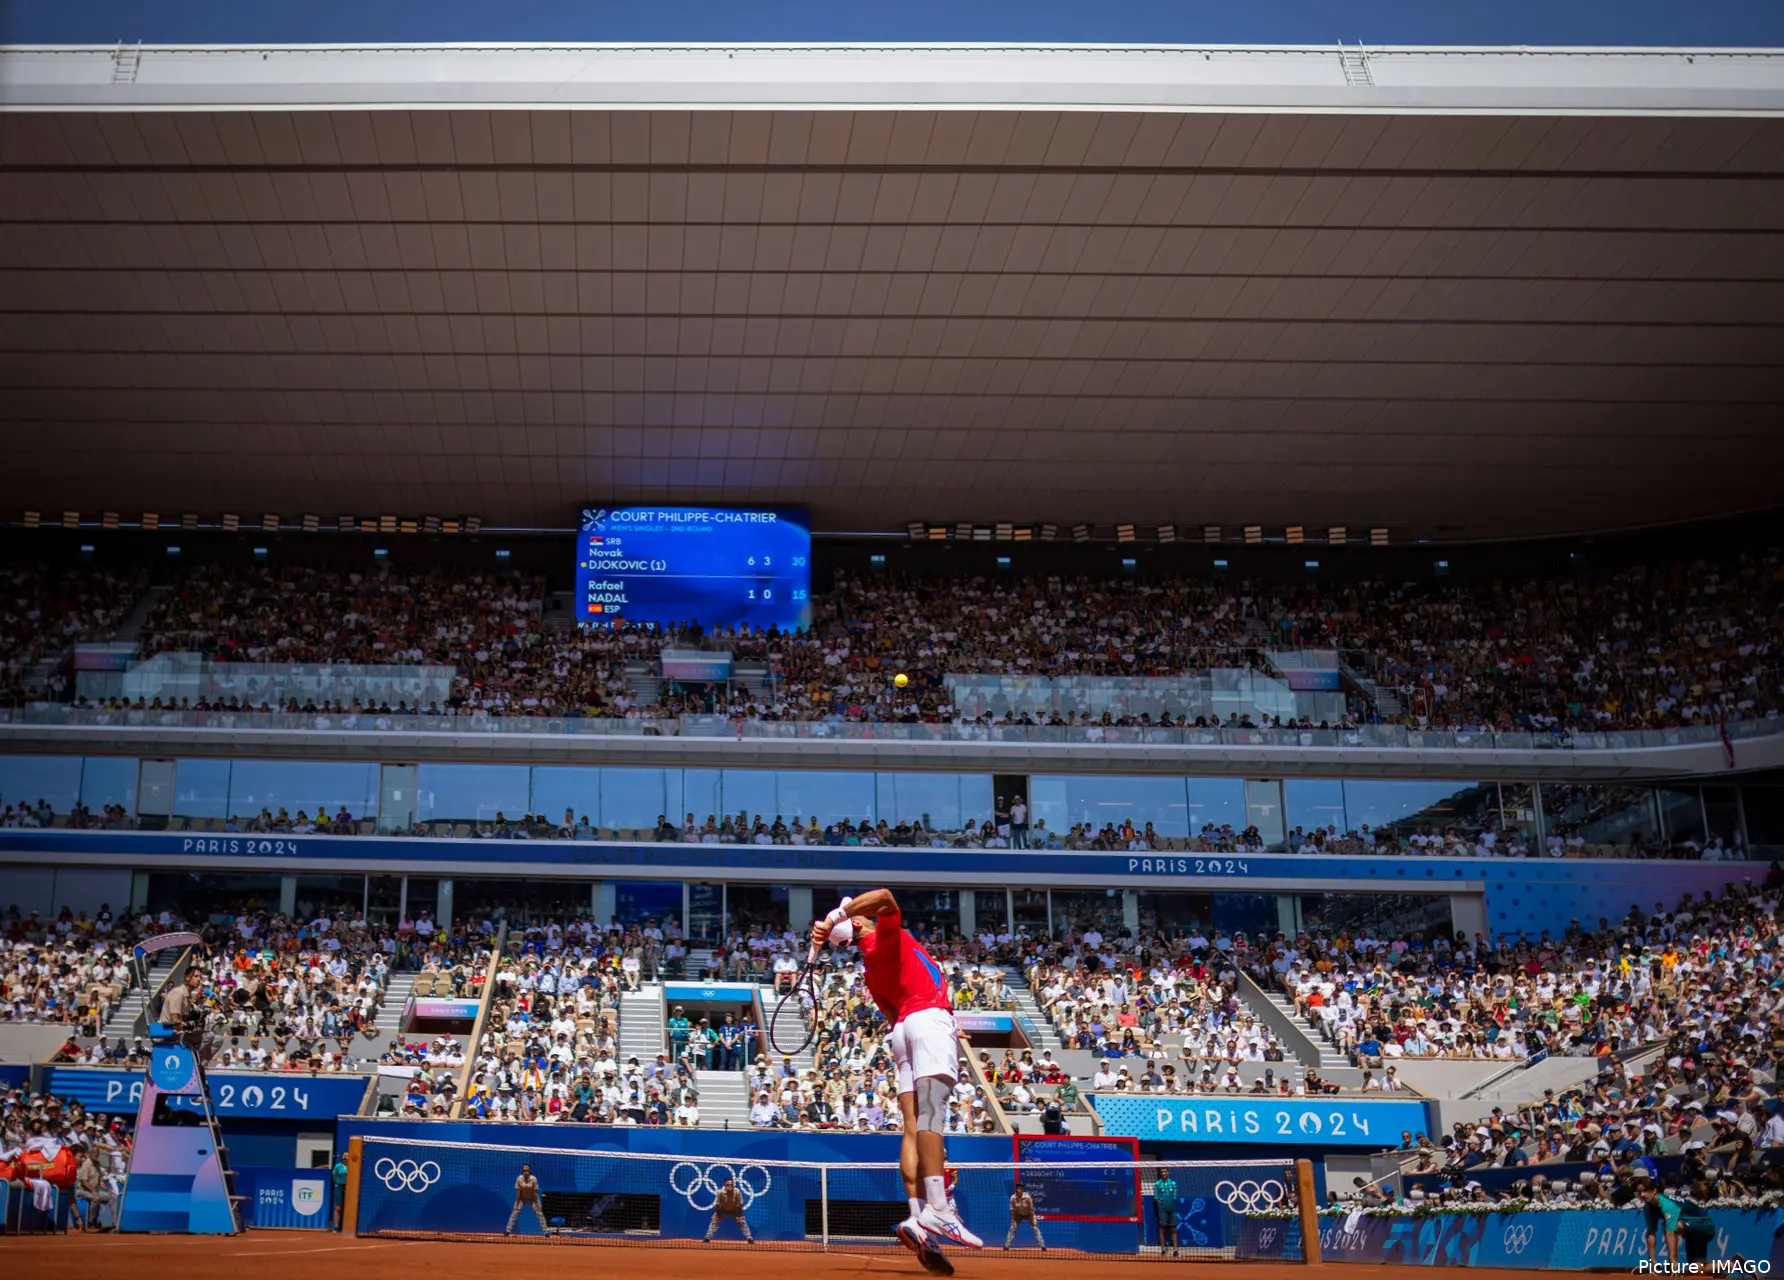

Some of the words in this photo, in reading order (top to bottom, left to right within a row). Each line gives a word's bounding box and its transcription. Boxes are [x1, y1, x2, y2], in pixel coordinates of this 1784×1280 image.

[611, 511, 654, 522] COURT
[658, 512, 777, 523] PHILIPPE-CHATRIER
[605, 537, 621, 545] SRB
[589, 548, 623, 557] Novak
[589, 560, 647, 570] DJOKOVIC
[650, 560, 666, 571] (1)
[747, 556, 755, 566] 6
[763, 556, 771, 566] 3
[791, 557, 806, 567] 30
[588, 580, 623, 590] Rafael
[588, 594, 628, 603] NADAL
[748, 589, 756, 599] 1
[763, 589, 772, 599] 0
[792, 590, 806, 600] 15
[604, 605, 620, 613] ESP
[246, 841, 297, 854] 2024
[1195, 860, 1248, 874] 2024
[219, 1084, 308, 1110] 2024
[1275, 1111, 1370, 1136] 2024
[298, 1191, 315, 1200] ITF
